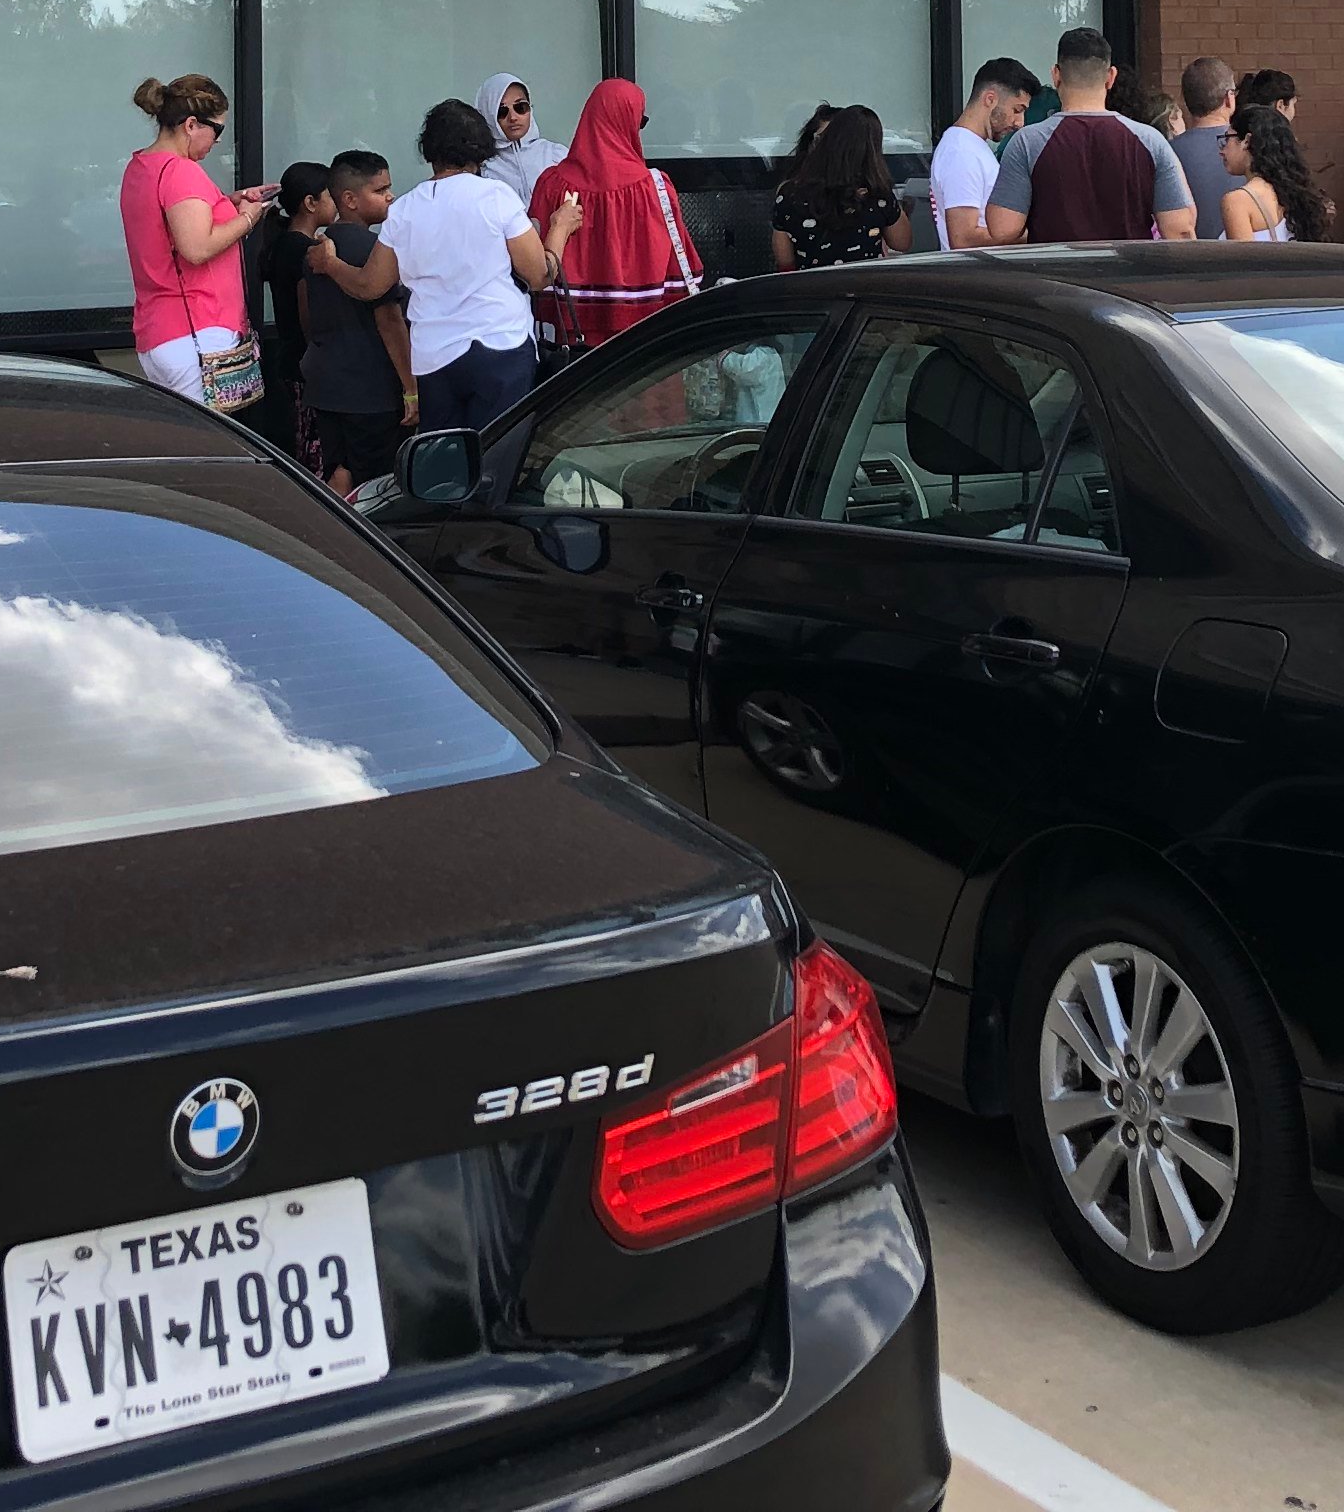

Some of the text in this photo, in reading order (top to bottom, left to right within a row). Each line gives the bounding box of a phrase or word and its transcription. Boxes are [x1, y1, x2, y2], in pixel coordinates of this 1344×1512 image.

[181, 1082, 254, 1120] BMW
[474, 1053, 655, 1124] 328d
[120, 1215, 260, 1274] TEXAS
[30, 1254, 354, 1409] KVN 4983
[123, 1372, 291, 1419] The Lone Star State
